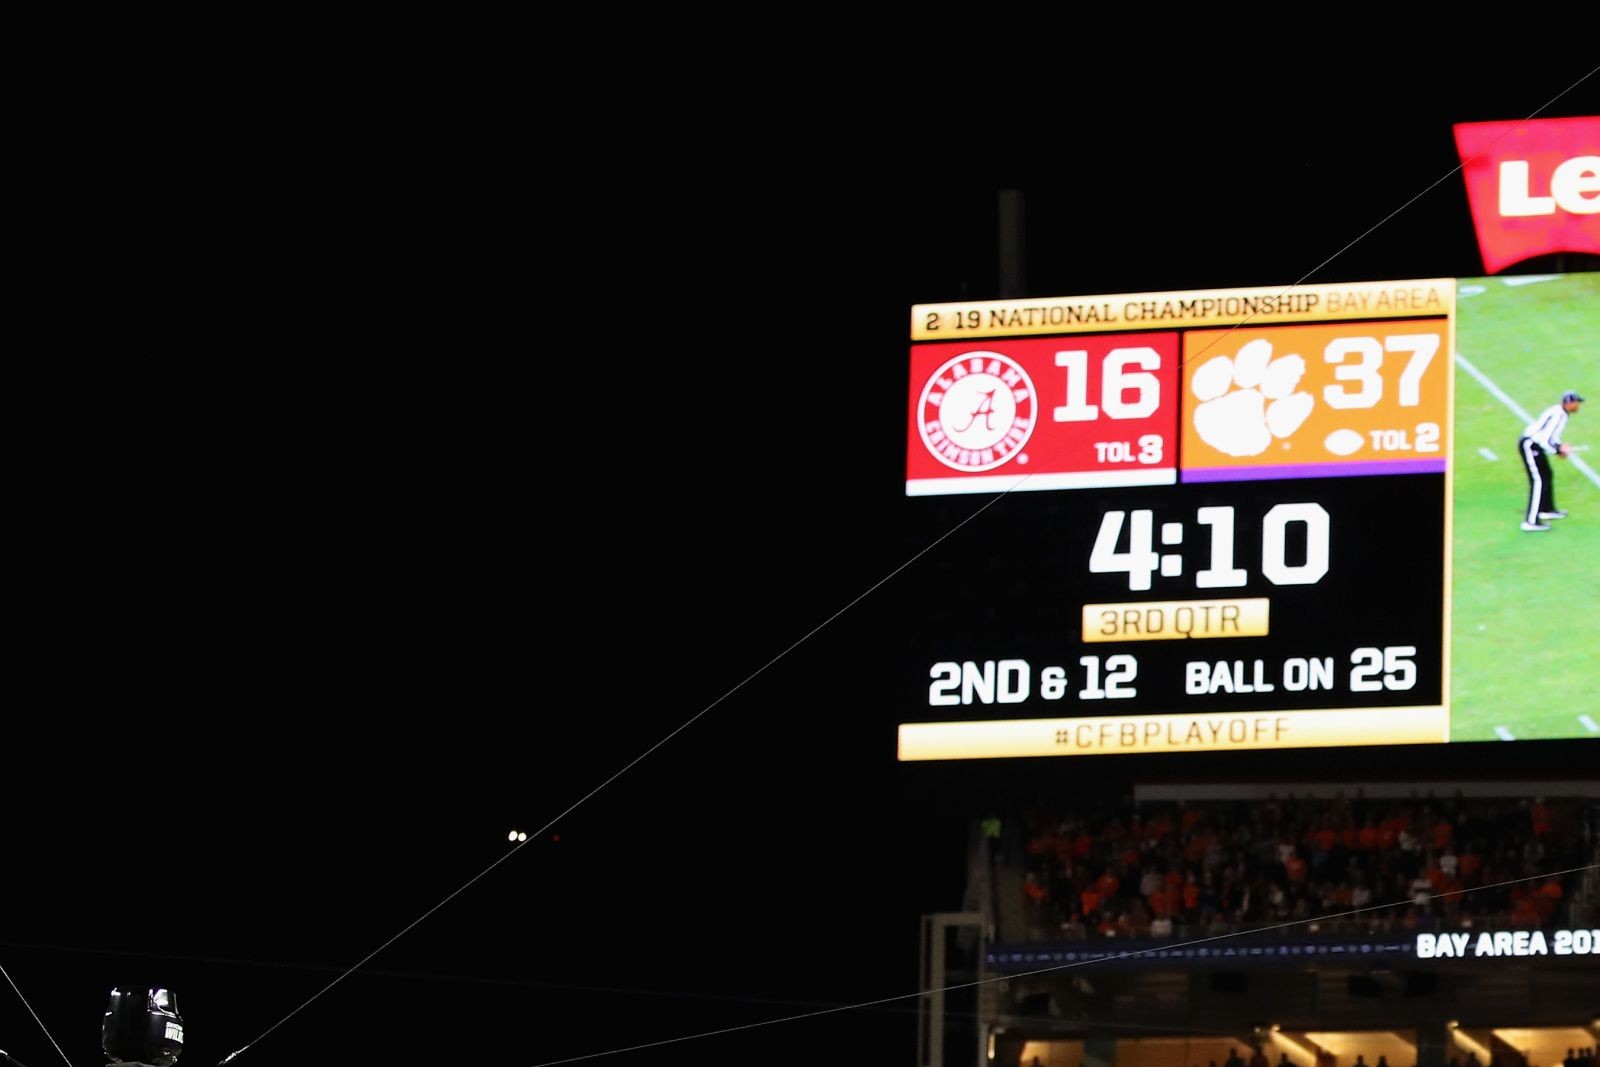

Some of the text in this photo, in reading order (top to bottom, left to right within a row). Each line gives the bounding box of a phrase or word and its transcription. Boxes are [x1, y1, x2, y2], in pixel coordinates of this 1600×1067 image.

[989, 303, 1117, 328] NATIONAL
[1123, 293, 1319, 322] CHAMPIONSHIP
[1326, 290, 1371, 313] BAY
[1371, 287, 1442, 311] AREA
[927, 357, 1032, 406] ALABAMA
[1053, 334, 1440, 422] 16 37
[1095, 434, 1163, 464] TOL 3
[1370, 423, 1440, 452] TOL 2
[1089, 502, 1331, 591] 4:10
[1100, 604, 1241, 638] 3RD QTR
[929, 646, 1417, 706] 2ND & 12 BALL ON 25
[1055, 717, 1291, 749] #CFBPLAYOFF
[1416, 934, 1470, 959] BAY
[1474, 931, 1548, 958] AREA
